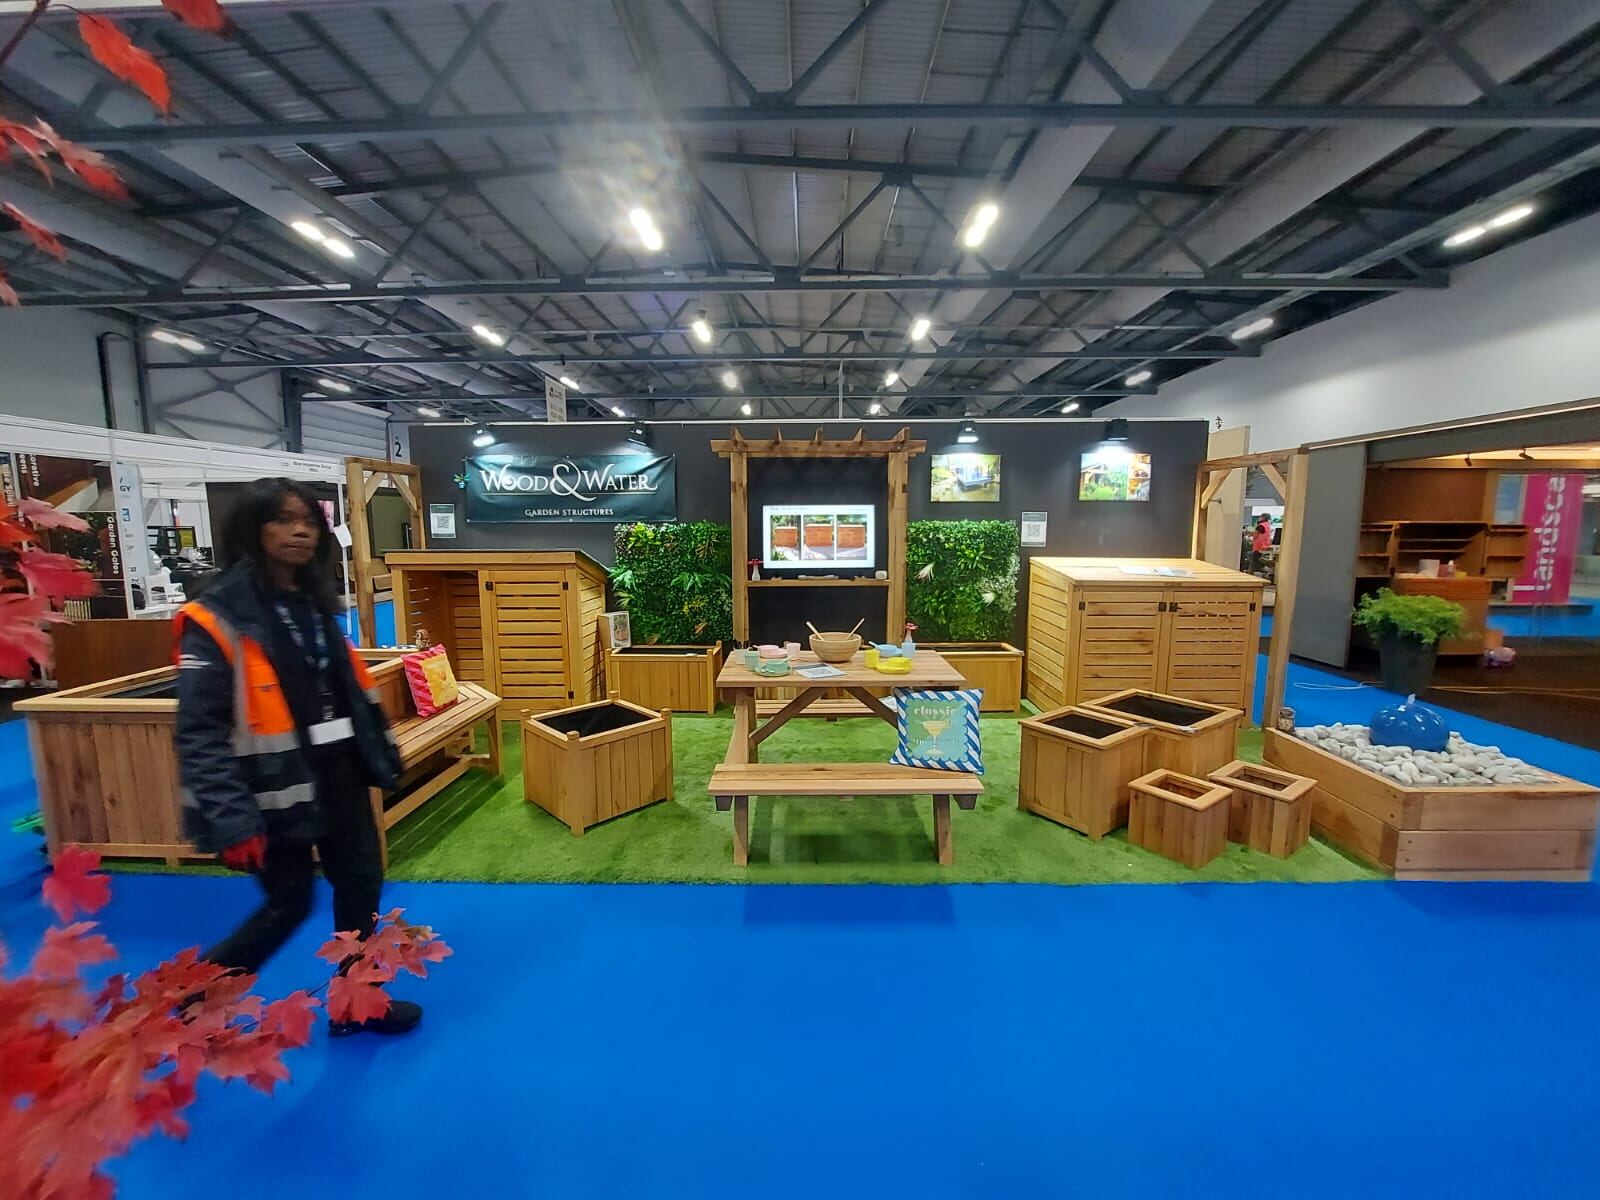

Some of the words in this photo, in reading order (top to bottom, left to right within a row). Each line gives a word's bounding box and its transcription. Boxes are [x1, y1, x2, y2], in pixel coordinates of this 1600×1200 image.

[394, 441, 402, 458] 2
[479, 463, 549, 492] WOOD
[550, 458, 597, 502] &
[582, 463, 658, 492] WATER
[525, 508, 560, 517] GARDEN
[562, 508, 614, 517] STRUCTURES
[107, 516, 117, 548] Garden
[111, 550, 120, 575] Gates
[914, 705, 958, 715] classic
